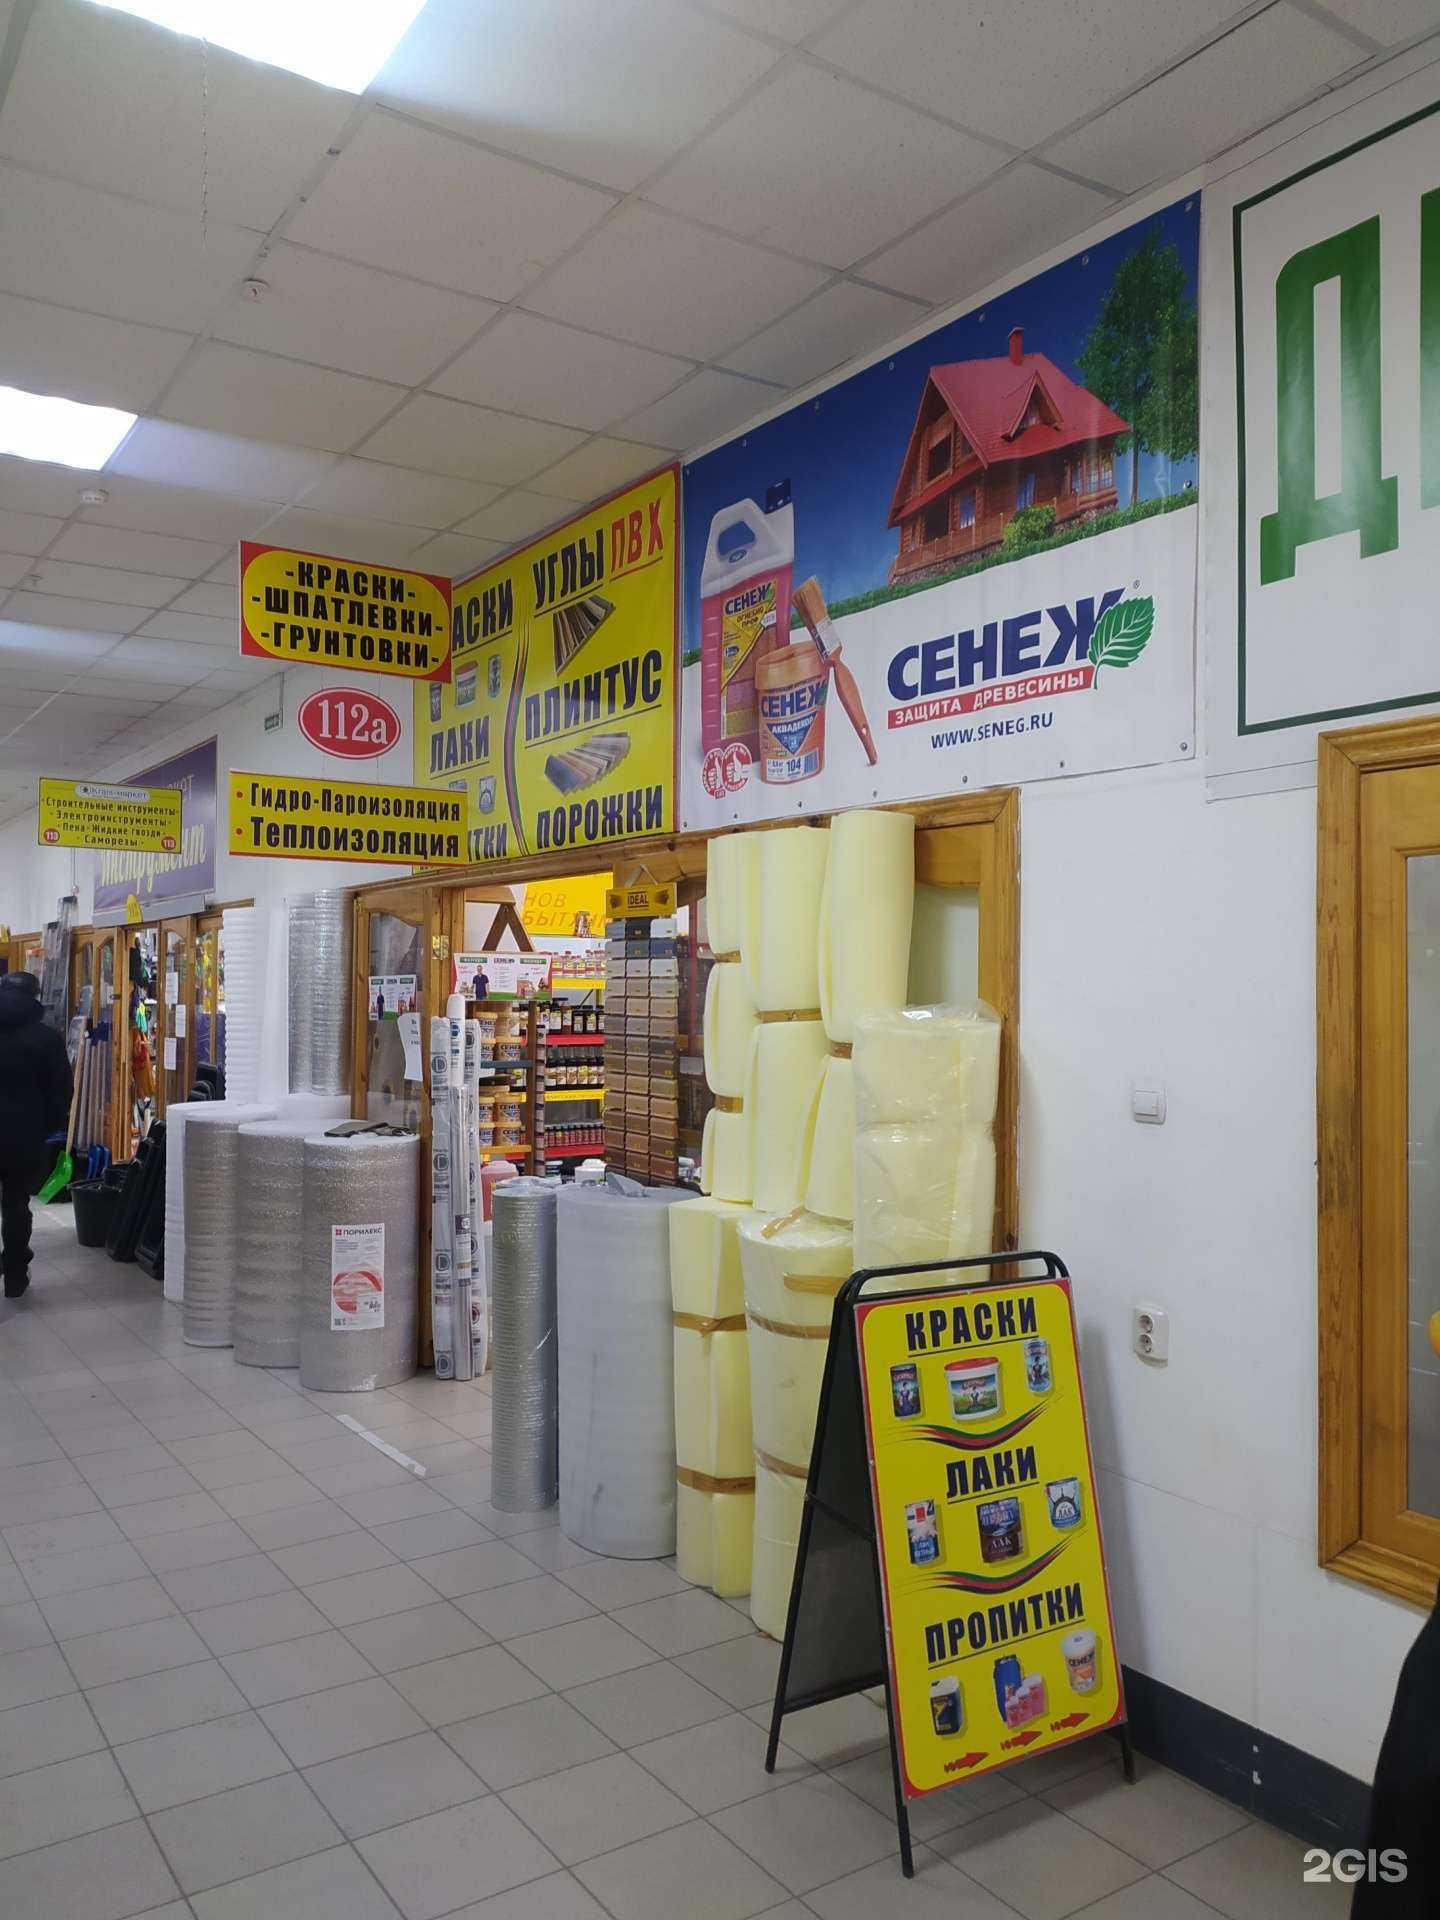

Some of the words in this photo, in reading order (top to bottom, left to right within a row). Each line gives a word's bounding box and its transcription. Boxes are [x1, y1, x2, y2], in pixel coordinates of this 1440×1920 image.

[610, 496, 664, 572] ПВХ
[532, 528, 605, 609] УГЛЫ
[452, 578, 513, 651] АСКИ
[725, 582, 772, 615] СЕНЕЖ
[887, 587, 1126, 701] СЕНЕЖ
[525, 649, 662, 742] ПЛИНТУС
[762, 680, 824, 718] СЕНЕЖ
[894, 698, 962, 725] ЗАЩИТА
[972, 670, 1085, 711] ДРЕВЕСИНЫ
[430, 715, 490, 774] ЛАКИ
[931, 711, 1054, 749] WWW.SENEG.RU
[250, 782, 460, 823] Гидро-Пароизоляция
[537, 784, 663, 850] ПОРОЖКИ
[84, 834, 138, 847] Саморезы
[250, 816, 459, 860] Теплоизоляция
[627, 892, 649, 905] IDEAL
[905, 1296, 1038, 1351] КРАСКИ
[946, 1445, 1038, 1499] ЛАКИ
[924, 1582, 1084, 1664] ПРОПИТКИ
